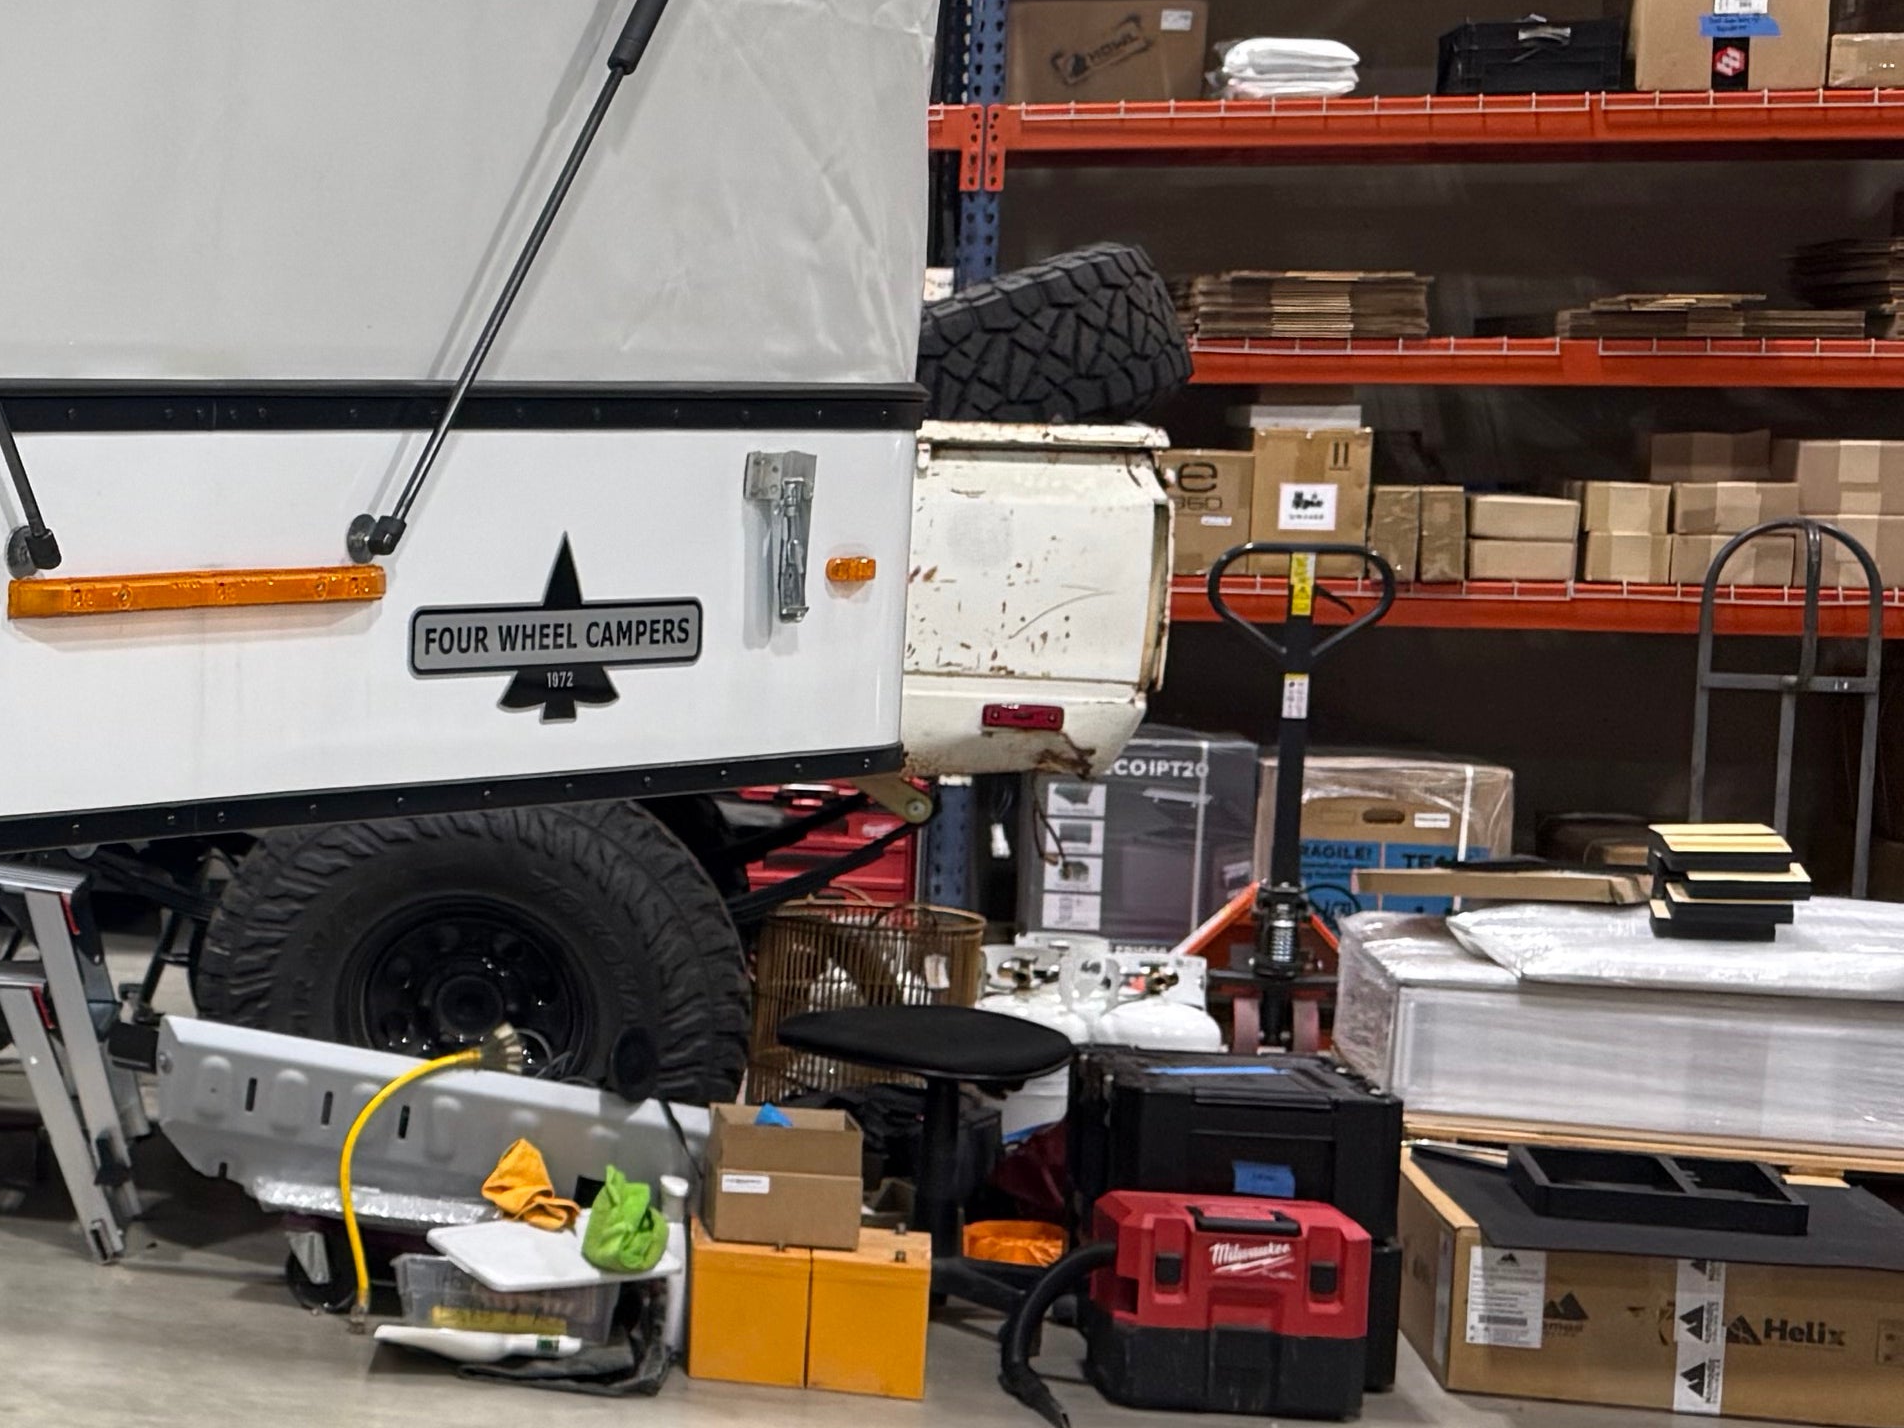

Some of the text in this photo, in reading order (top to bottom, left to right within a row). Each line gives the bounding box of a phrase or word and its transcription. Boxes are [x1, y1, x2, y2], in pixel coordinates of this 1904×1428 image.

[424, 617, 690, 655] FOUR WHEEL CAMPERS
[546, 670, 575, 689] 1972
[1104, 758, 1210, 778] COIPT20
[1209, 1241, 1291, 1266] Milwaukee
[1763, 1317, 1845, 1347] Helix
